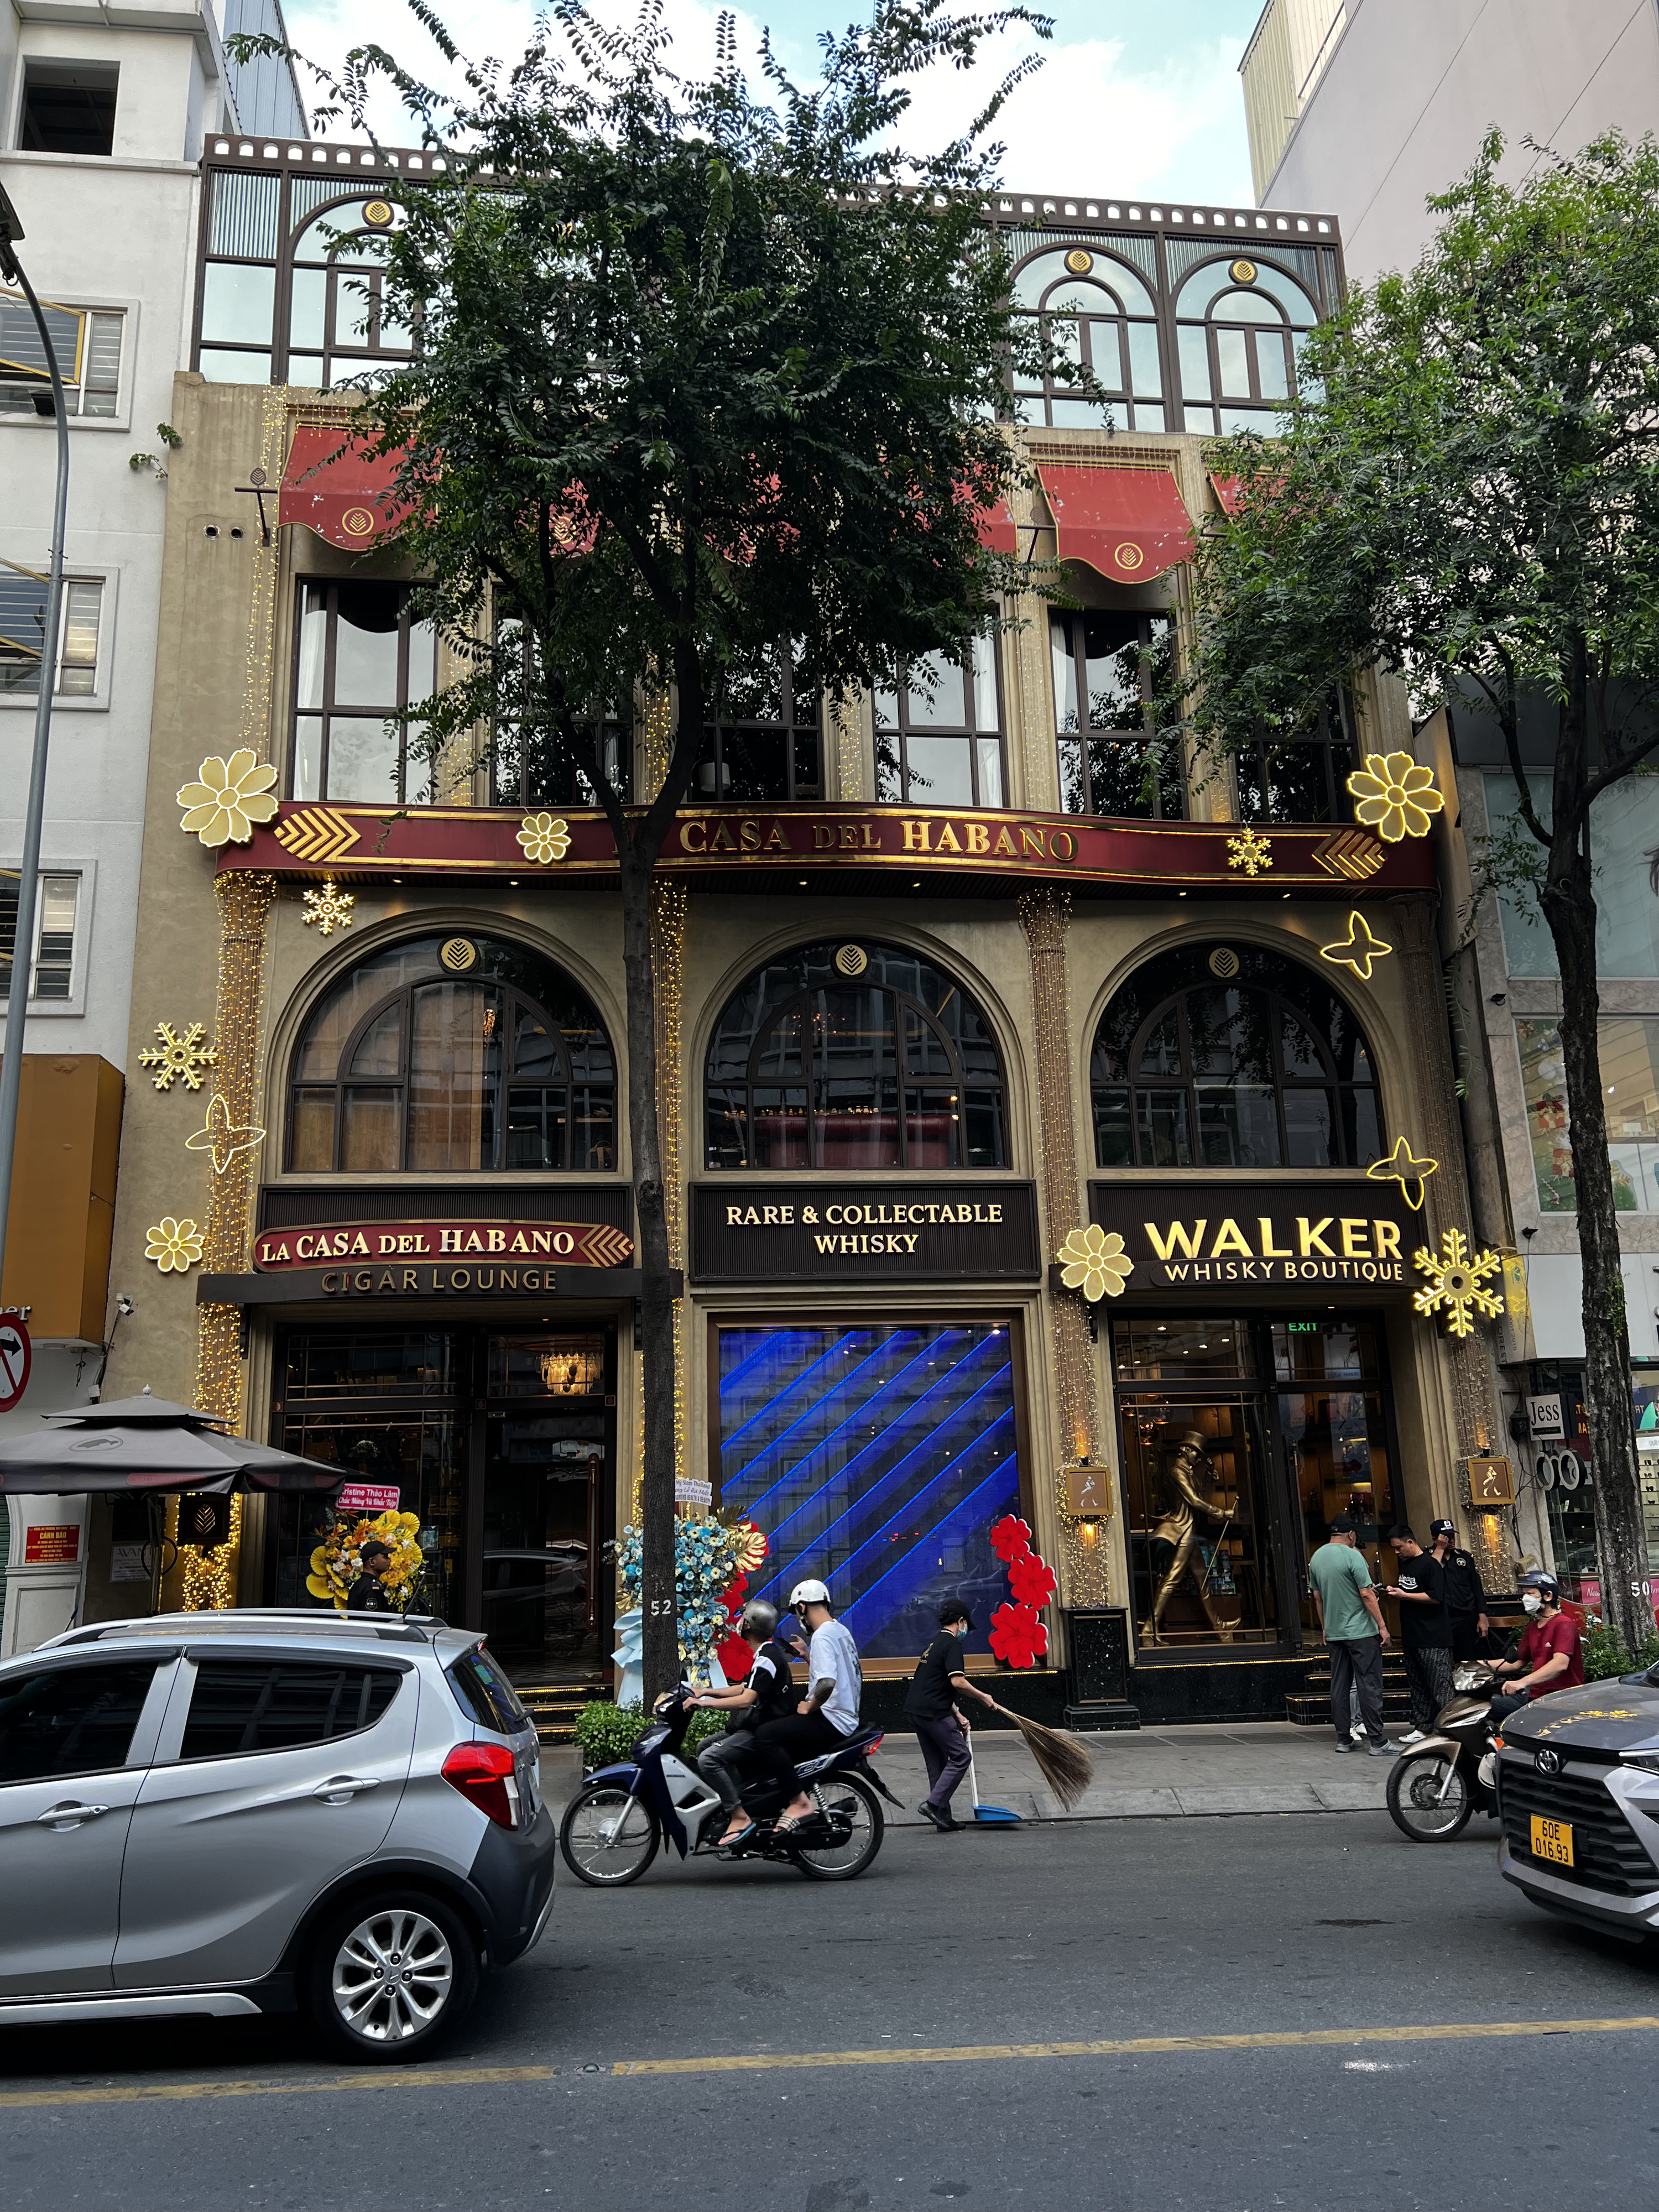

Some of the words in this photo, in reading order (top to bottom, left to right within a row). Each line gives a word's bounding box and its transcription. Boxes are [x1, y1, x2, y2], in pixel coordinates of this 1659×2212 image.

[680, 820, 792, 852] CASA
[813, 823, 881, 849] DEL
[901, 820, 1079, 861] HABANO
[726, 1206, 794, 1225] RARE
[802, 1206, 820, 1224] &
[826, 1204, 1003, 1225] COLLECTABLE
[261, 1243, 291, 1262] LA
[295, 1231, 371, 1259] CASA
[378, 1234, 430, 1254] DEL
[437, 1229, 575, 1256] HABANO
[813, 1234, 920, 1254] WHISKY
[1144, 1218, 1404, 1261] WALKER
[321, 1270, 419, 1293] CIGAR
[432, 1269, 556, 1291] LOUNGE
[1164, 1261, 1275, 1282] WHISKY
[1285, 1261, 1404, 1282] BOUTIQUE
[1288, 1323, 1318, 1331] EXIT
[1530, 1401, 1559, 1426] Jess
[342, 1488, 365, 1496] ristine
[693, 1480, 711, 1489] Thailand
[1631, 1582, 1650, 1597] 50
[651, 1599, 671, 1616] 52
[1542, 1820, 1560, 1841] 60E
[1536, 1837, 1569, 1863] 016.93
